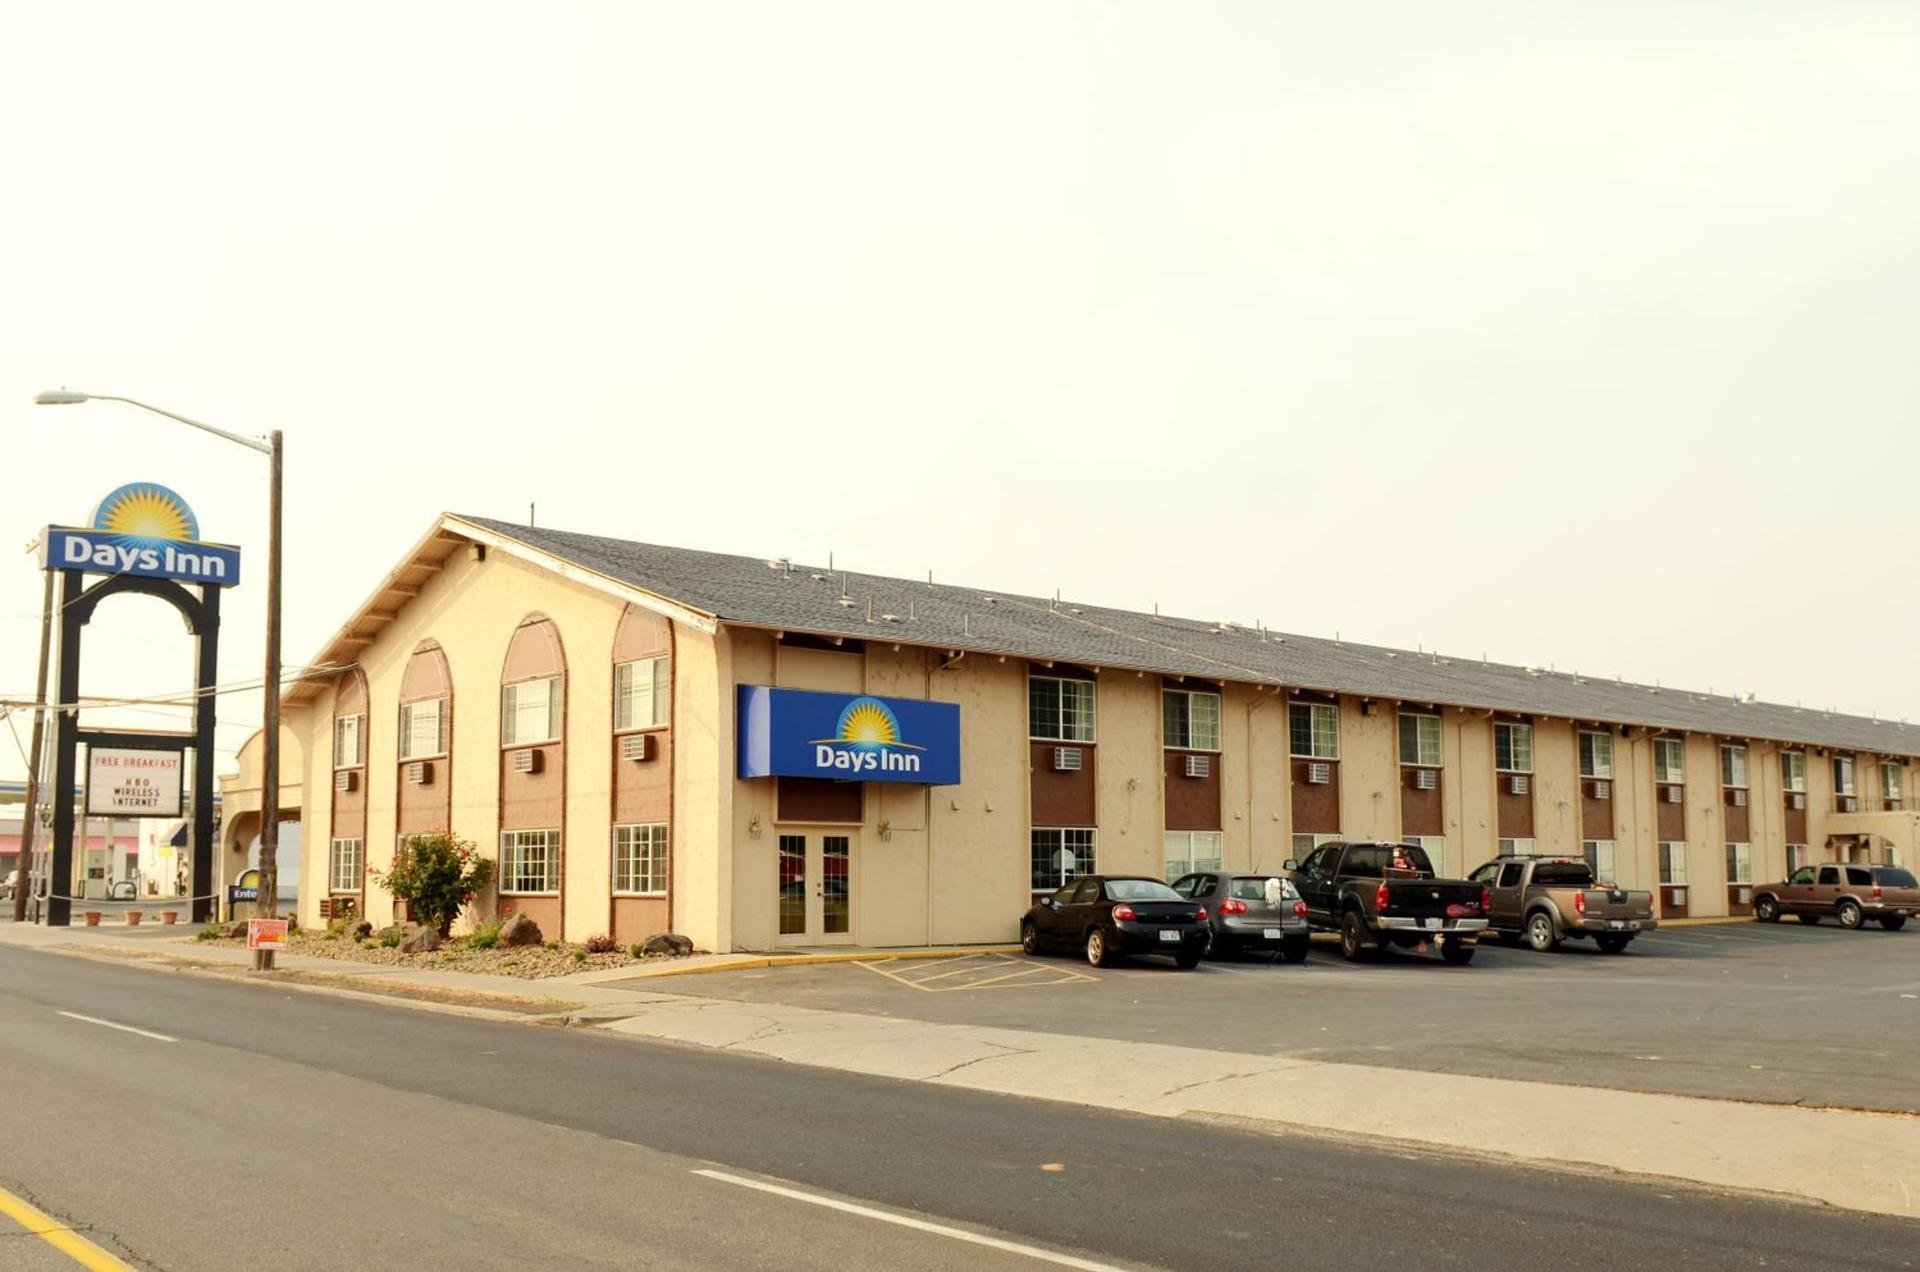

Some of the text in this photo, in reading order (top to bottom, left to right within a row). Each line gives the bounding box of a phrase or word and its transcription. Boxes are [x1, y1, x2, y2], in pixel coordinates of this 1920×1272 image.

[64, 536, 225, 577] Days Inn
[95, 757, 177, 768] FREE BREAKFAST
[816, 745, 920, 772] Days Inn
[114, 788, 160, 797] WIRELESS
[113, 798, 158, 807] INTERNET
[234, 890, 258, 898] Ente
